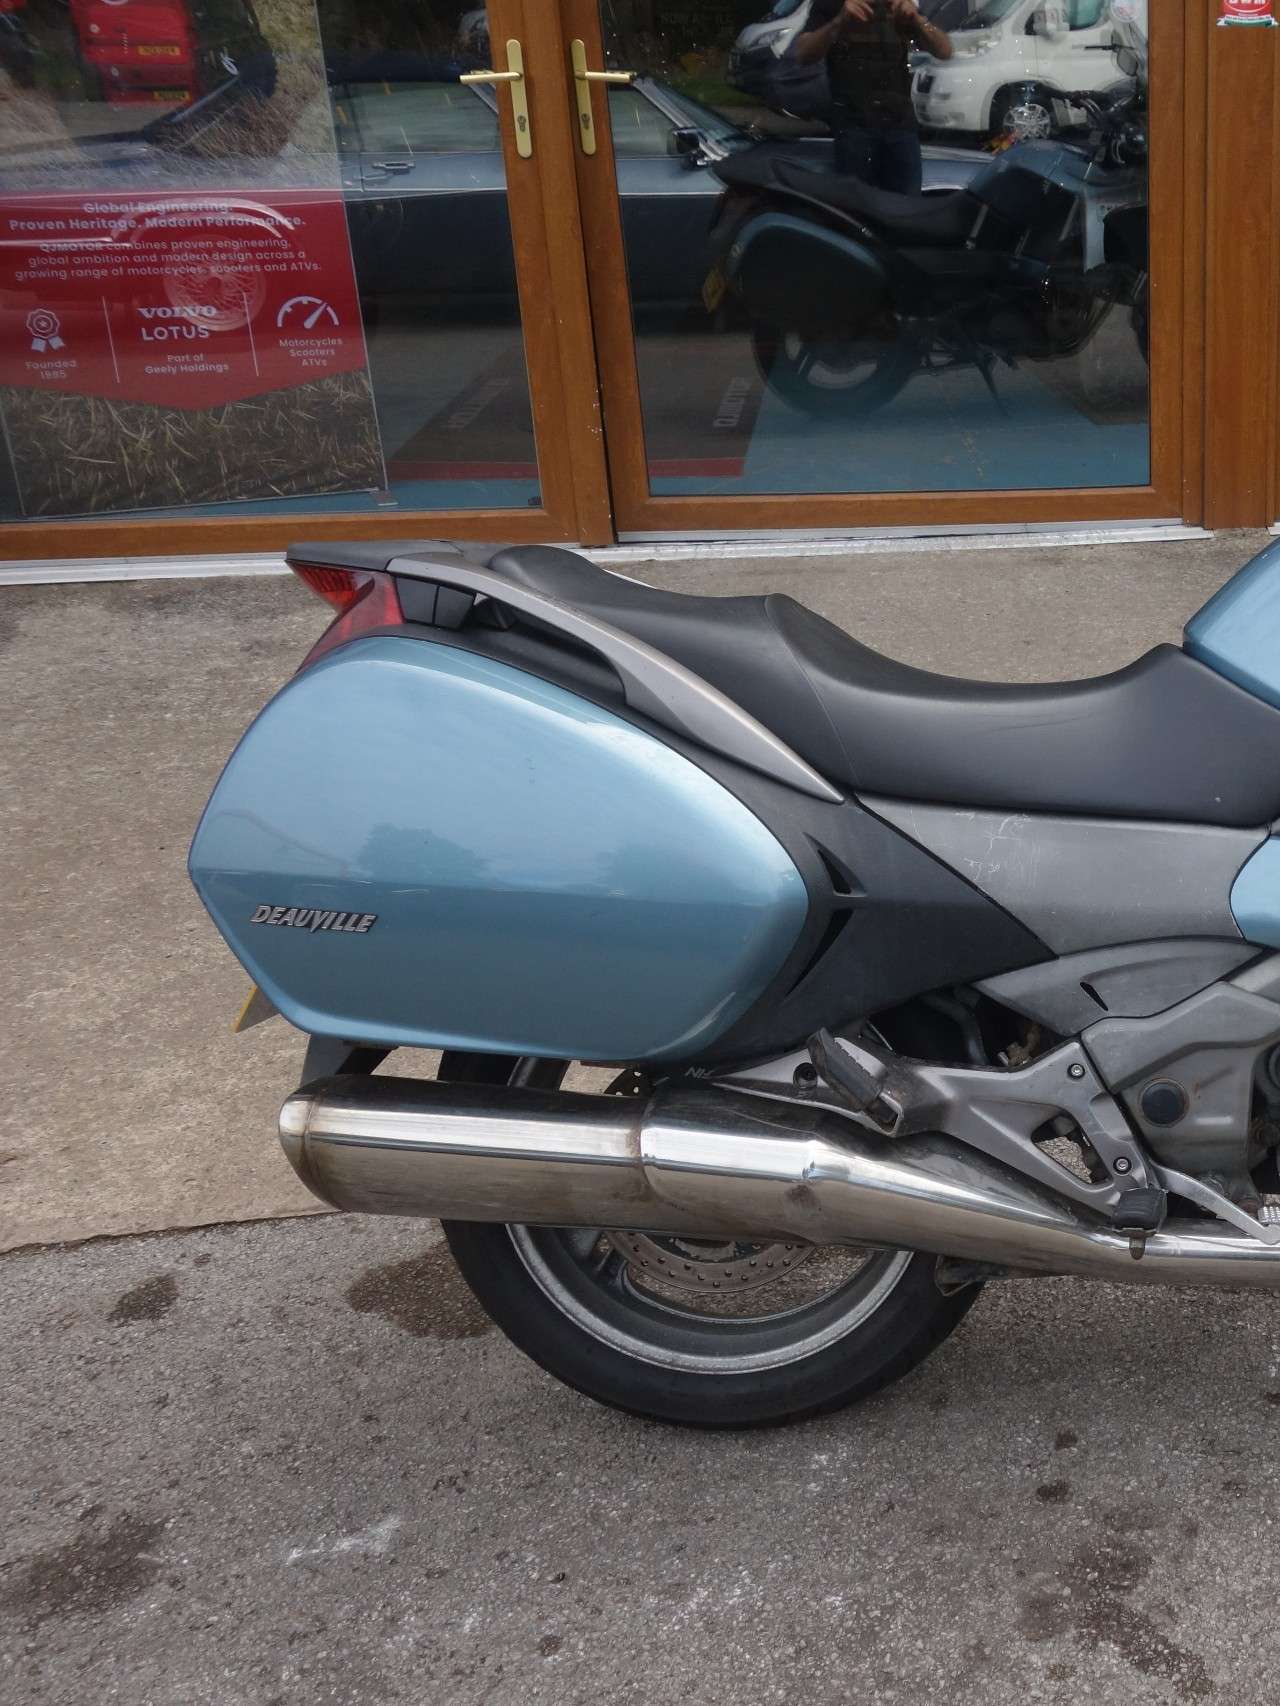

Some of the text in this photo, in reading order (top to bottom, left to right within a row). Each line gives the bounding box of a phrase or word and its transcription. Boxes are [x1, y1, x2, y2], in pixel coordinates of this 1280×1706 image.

[83, 203, 134, 213] Global
[9, 219, 66, 231] Proven
[69, 218, 142, 231] Heritage.
[145, 217, 203, 228] Modern
[107, 240, 168, 250] combines
[172, 241, 213, 252] proven
[28, 256, 69, 267] global
[72, 254, 130, 264] ambition
[133, 253, 158, 263] and
[161, 252, 209, 262] modern
[213, 251, 252, 262] design
[255, 252, 295, 260] across
[15, 270, 67, 281] growing
[71, 268, 108, 279] range
[111, 267, 124, 276] of
[211, 264, 261, 273] scooters
[264, 262, 287, 272] and
[137, 306, 217, 318] VOLVO
[141, 325, 209, 341] LOTUS
[279, 337, 343, 347] Motorcycles
[167, 353, 204, 363] Part of
[289, 348, 336, 357] Scooters
[25, 360, 77, 370] Founded
[145, 362, 230, 375] Geely Holdings
[302, 358, 328, 367] ATVs
[251, 905, 377, 933] DEAUVILLE
